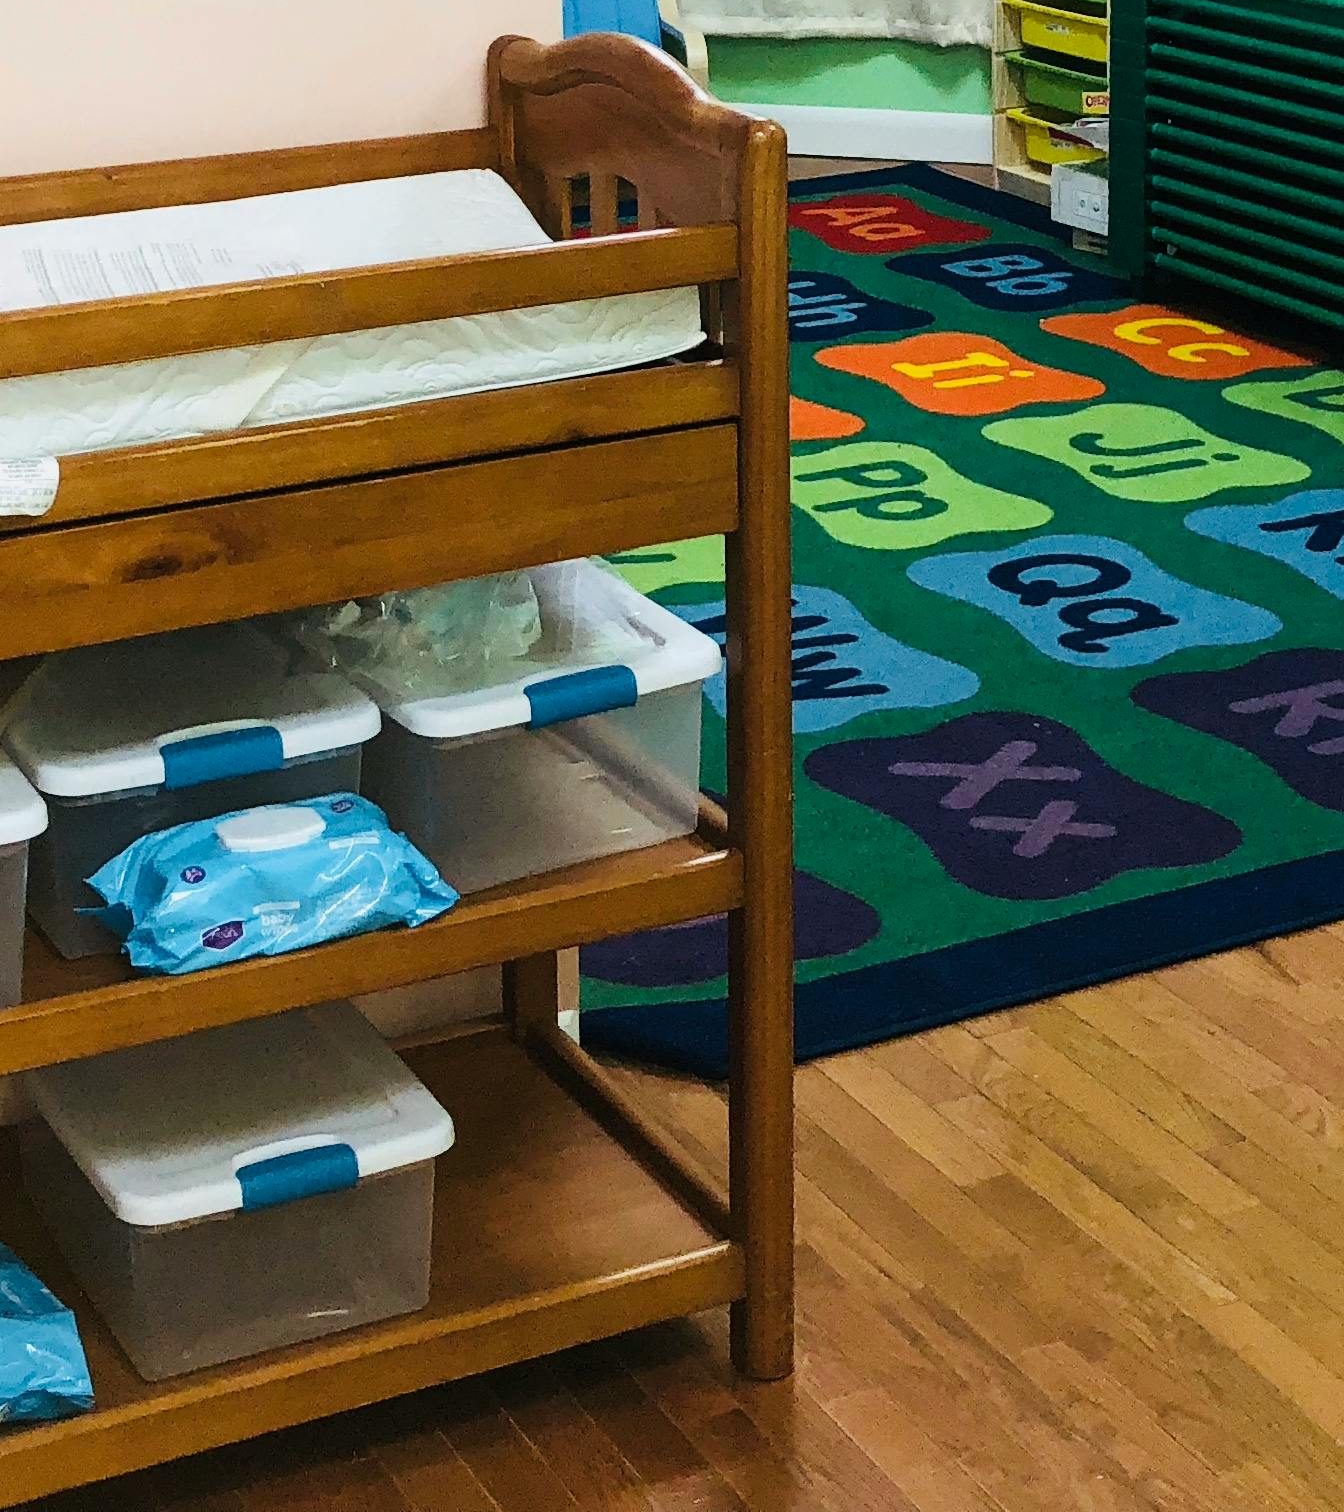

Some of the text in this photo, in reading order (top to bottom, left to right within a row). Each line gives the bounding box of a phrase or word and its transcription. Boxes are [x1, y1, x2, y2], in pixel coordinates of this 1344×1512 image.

[800, 207, 925, 240] Aa
[940, 255, 1074, 296] Bb
[1113, 317, 1250, 364] Cc
[890, 351, 1035, 390] Ii
[1068, 431, 1241, 479] Jj
[793, 459, 949, 522] Pp
[986, 553, 1180, 654] Qq
[888, 740, 1118, 857] Xx
